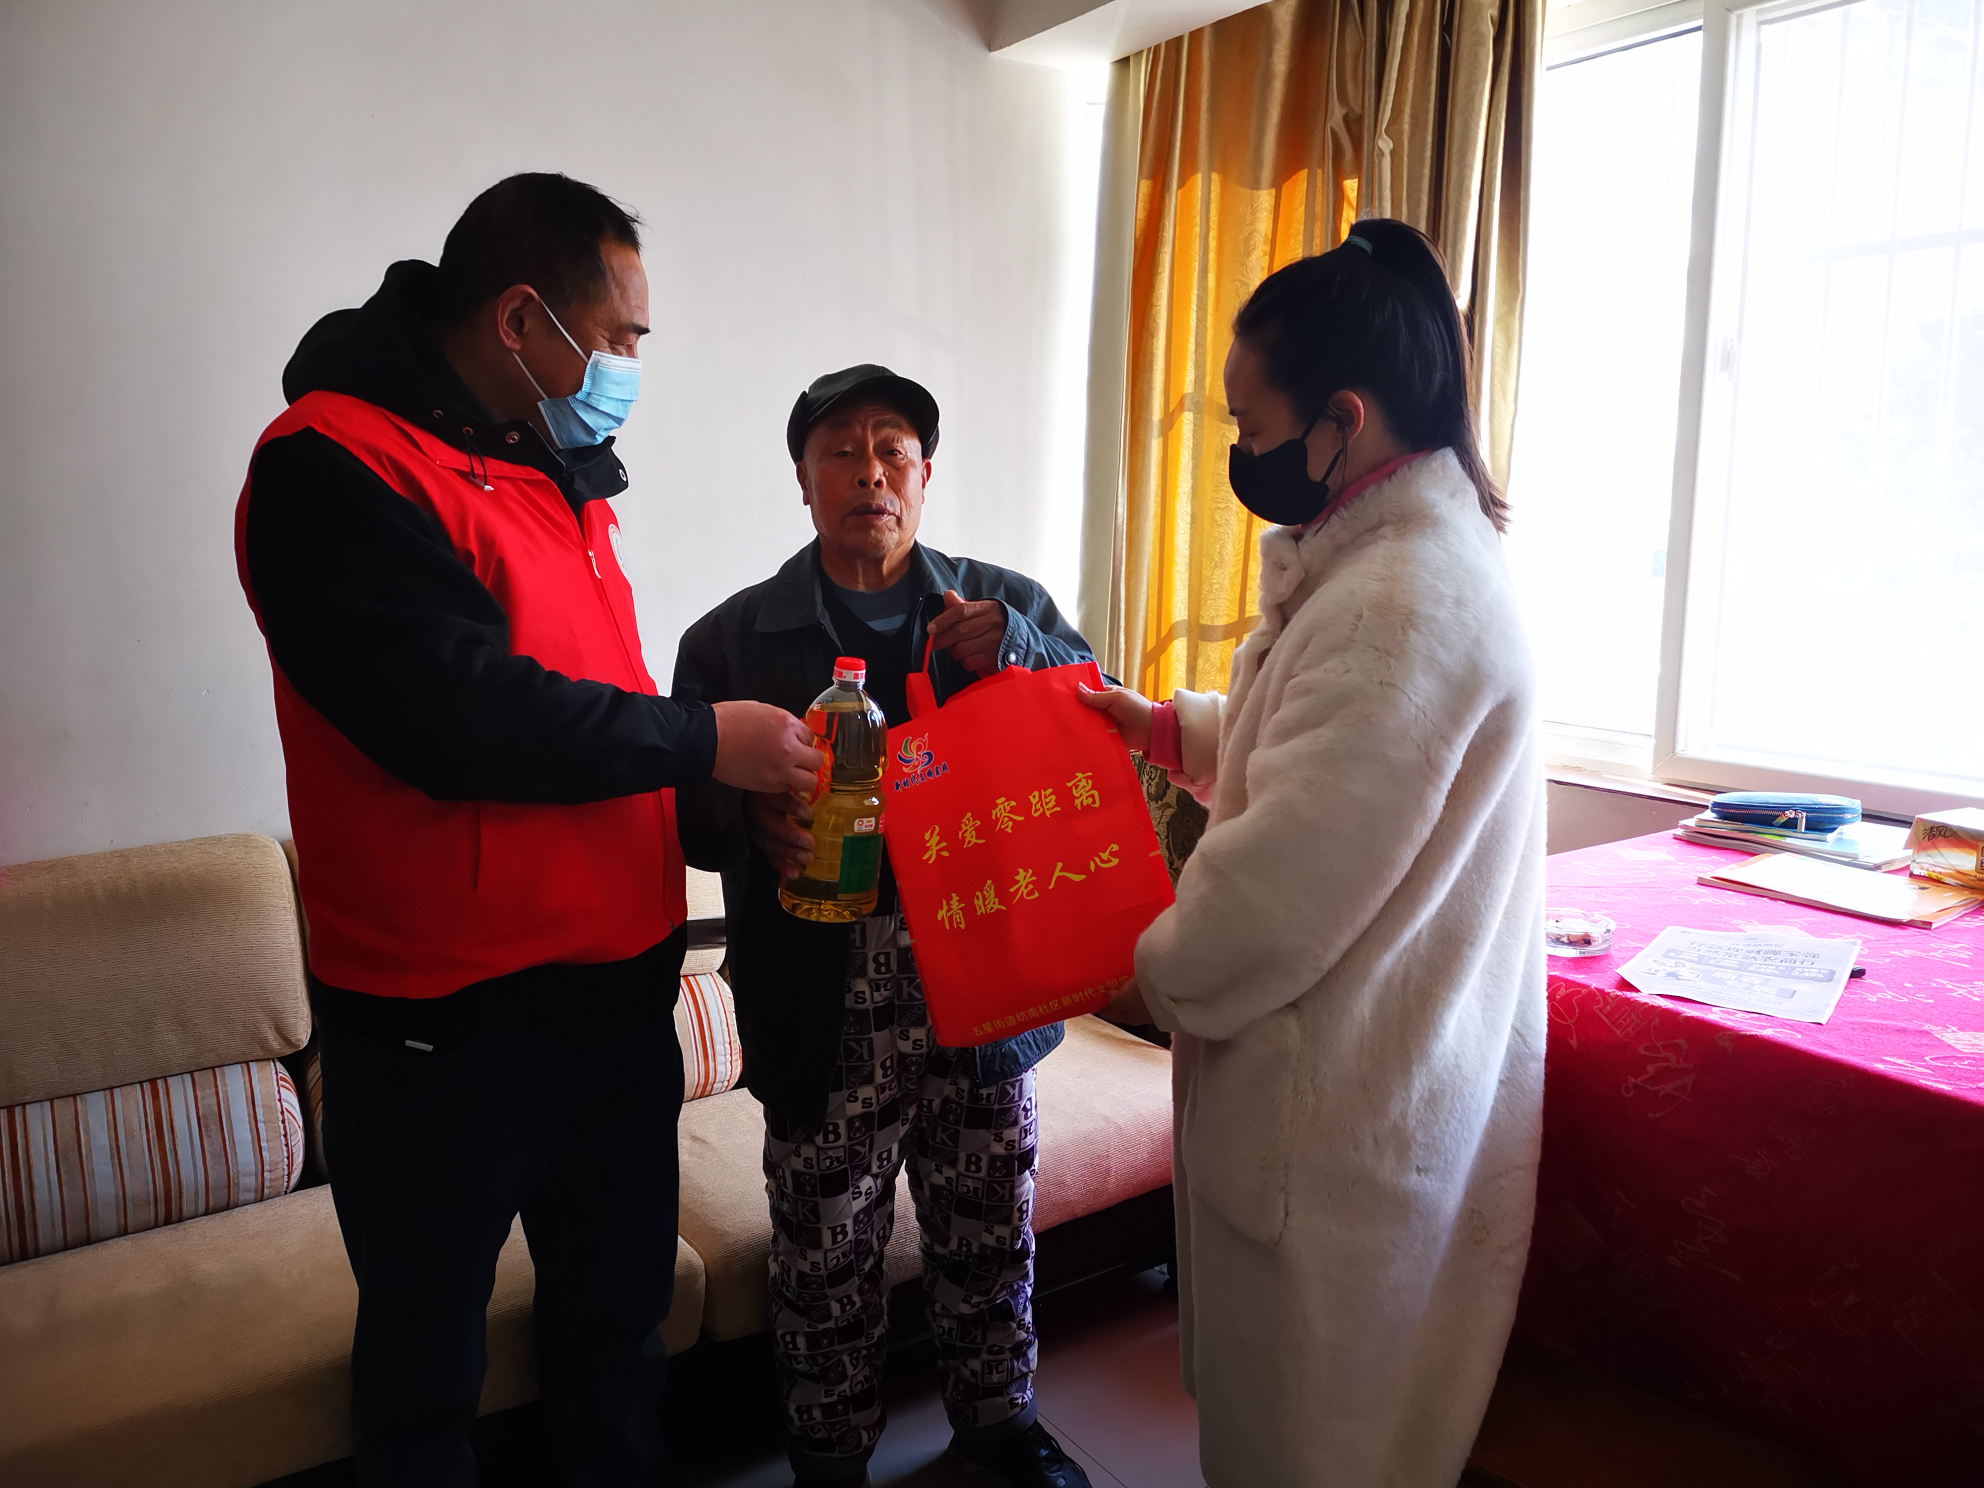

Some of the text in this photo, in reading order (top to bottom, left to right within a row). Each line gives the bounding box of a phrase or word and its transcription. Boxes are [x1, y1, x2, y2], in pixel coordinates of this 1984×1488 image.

[921, 771, 1101, 864] 关爱零距离
[1922, 825, 1954, 842] 清风
[936, 842, 1120, 931] 情暖老人心
[971, 973, 1134, 1038] 五星街道纺南社区新时代文明实
